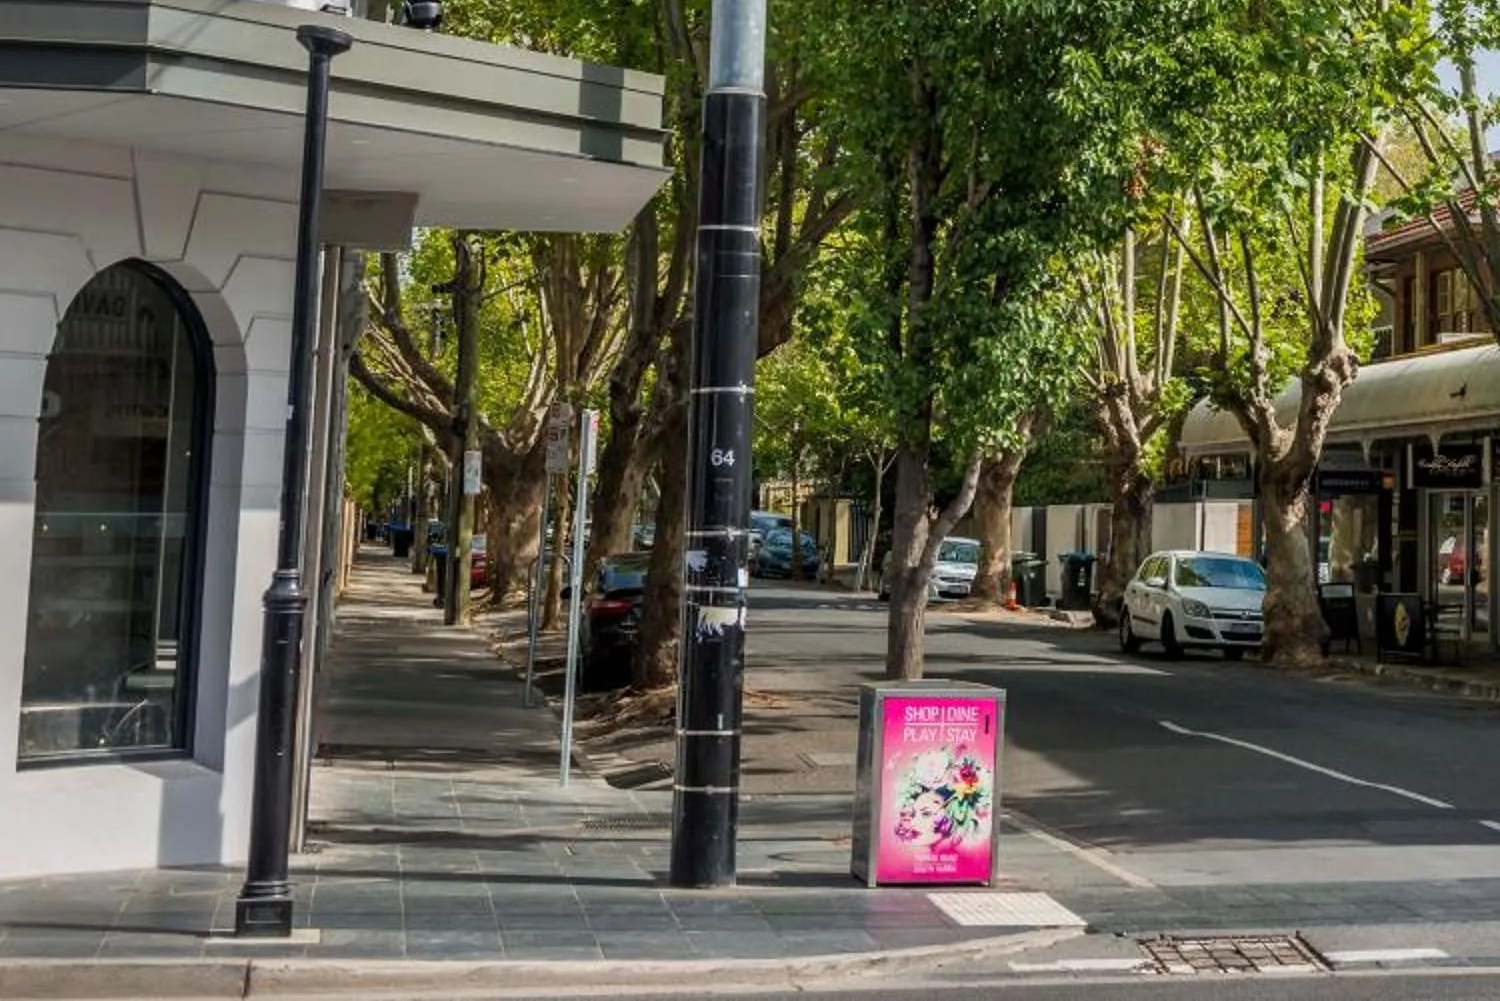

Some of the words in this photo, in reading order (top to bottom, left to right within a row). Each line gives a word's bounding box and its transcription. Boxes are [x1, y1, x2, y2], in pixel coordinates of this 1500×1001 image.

[711, 449, 735, 466] 64
[905, 706, 939, 722] SHOP
[947, 706, 979, 722] DINE
[903, 727, 937, 742] PLAY
[947, 727, 977, 742] STAY
